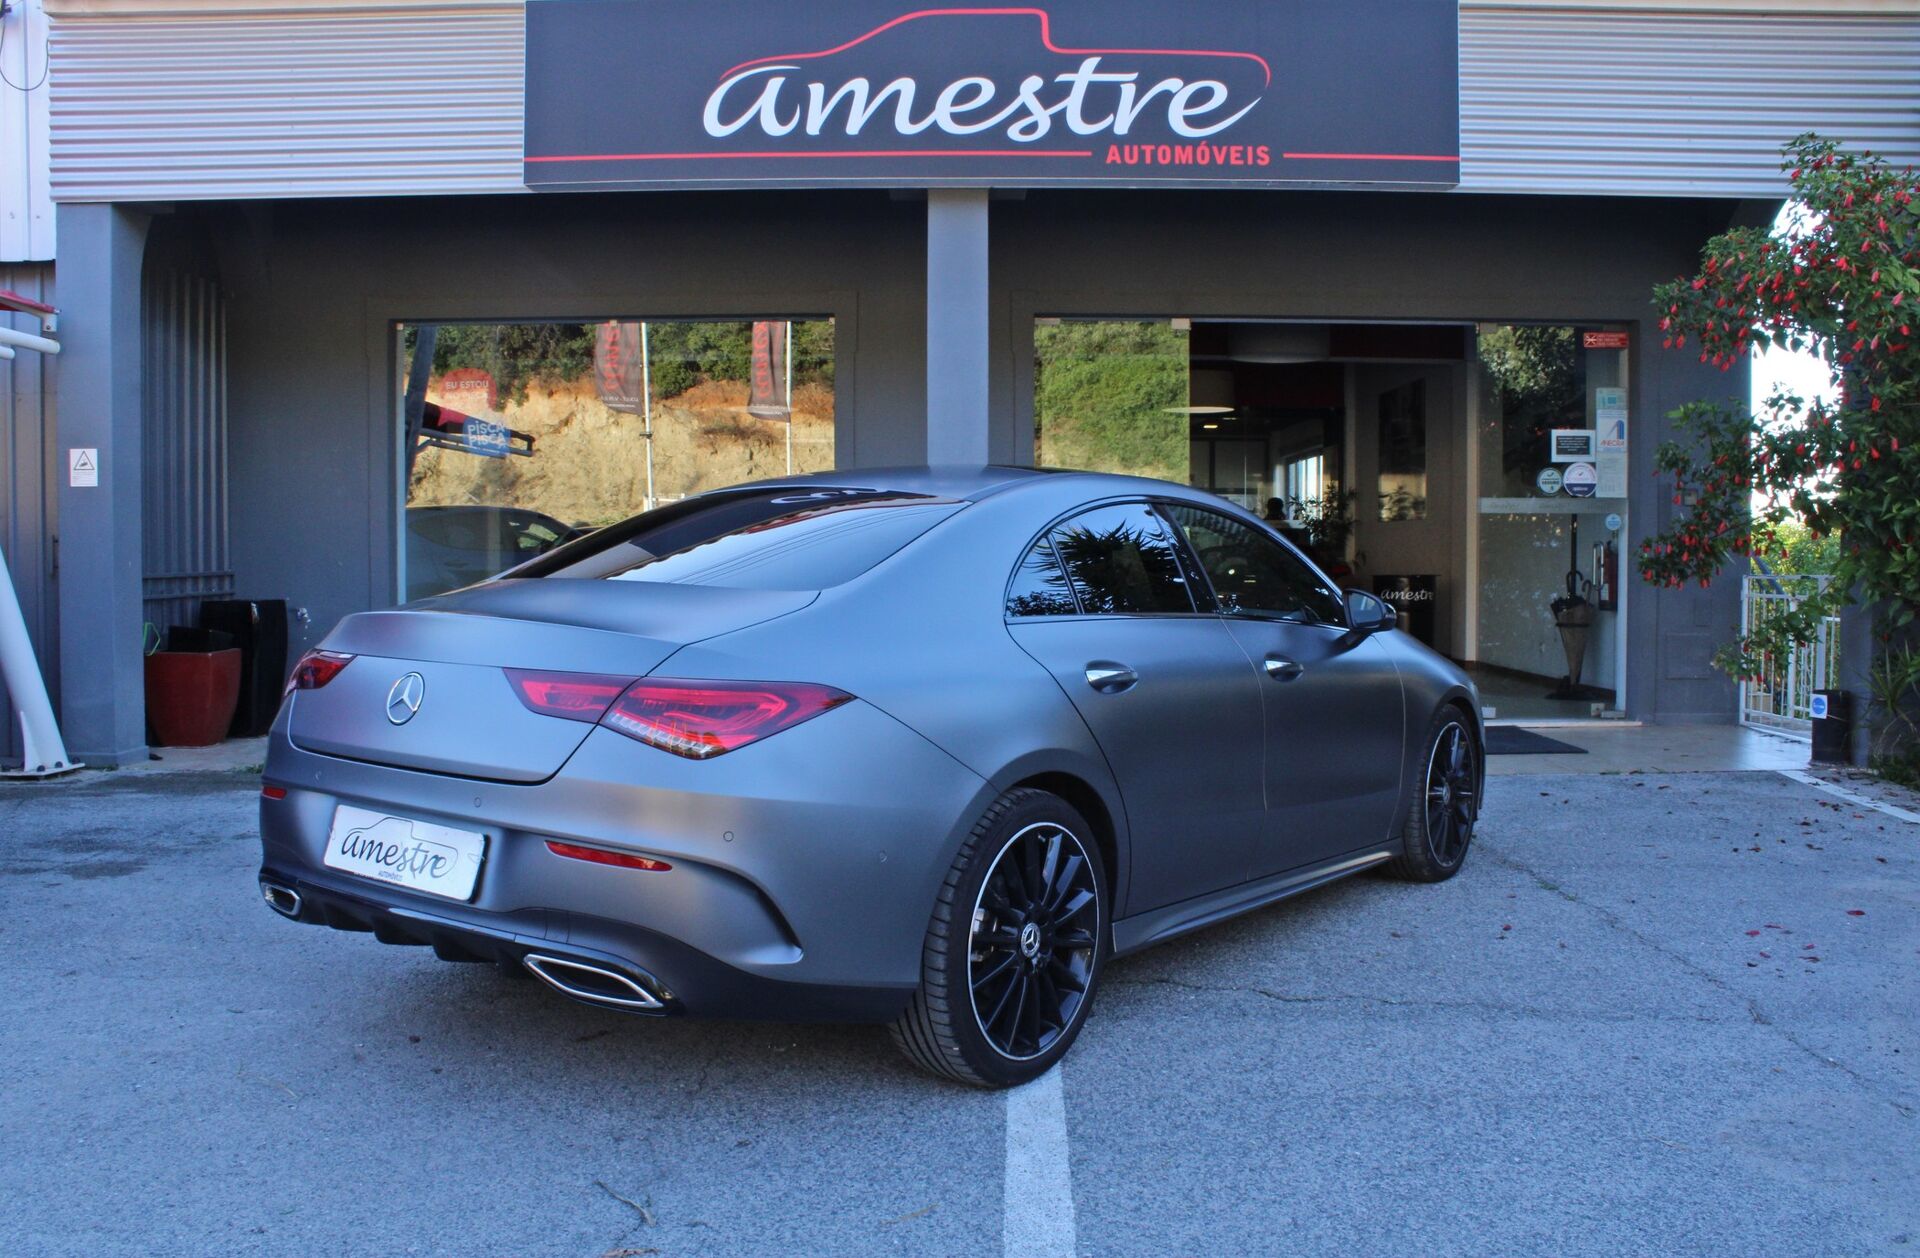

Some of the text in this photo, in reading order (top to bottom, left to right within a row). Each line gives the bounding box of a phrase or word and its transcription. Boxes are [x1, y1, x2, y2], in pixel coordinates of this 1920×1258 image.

[703, 57, 1262, 142] amestre
[1106, 140, 1270, 166] AUTOMÓVEIS
[461, 380, 489, 389] ESTOU
[342, 831, 454, 879] amestre
